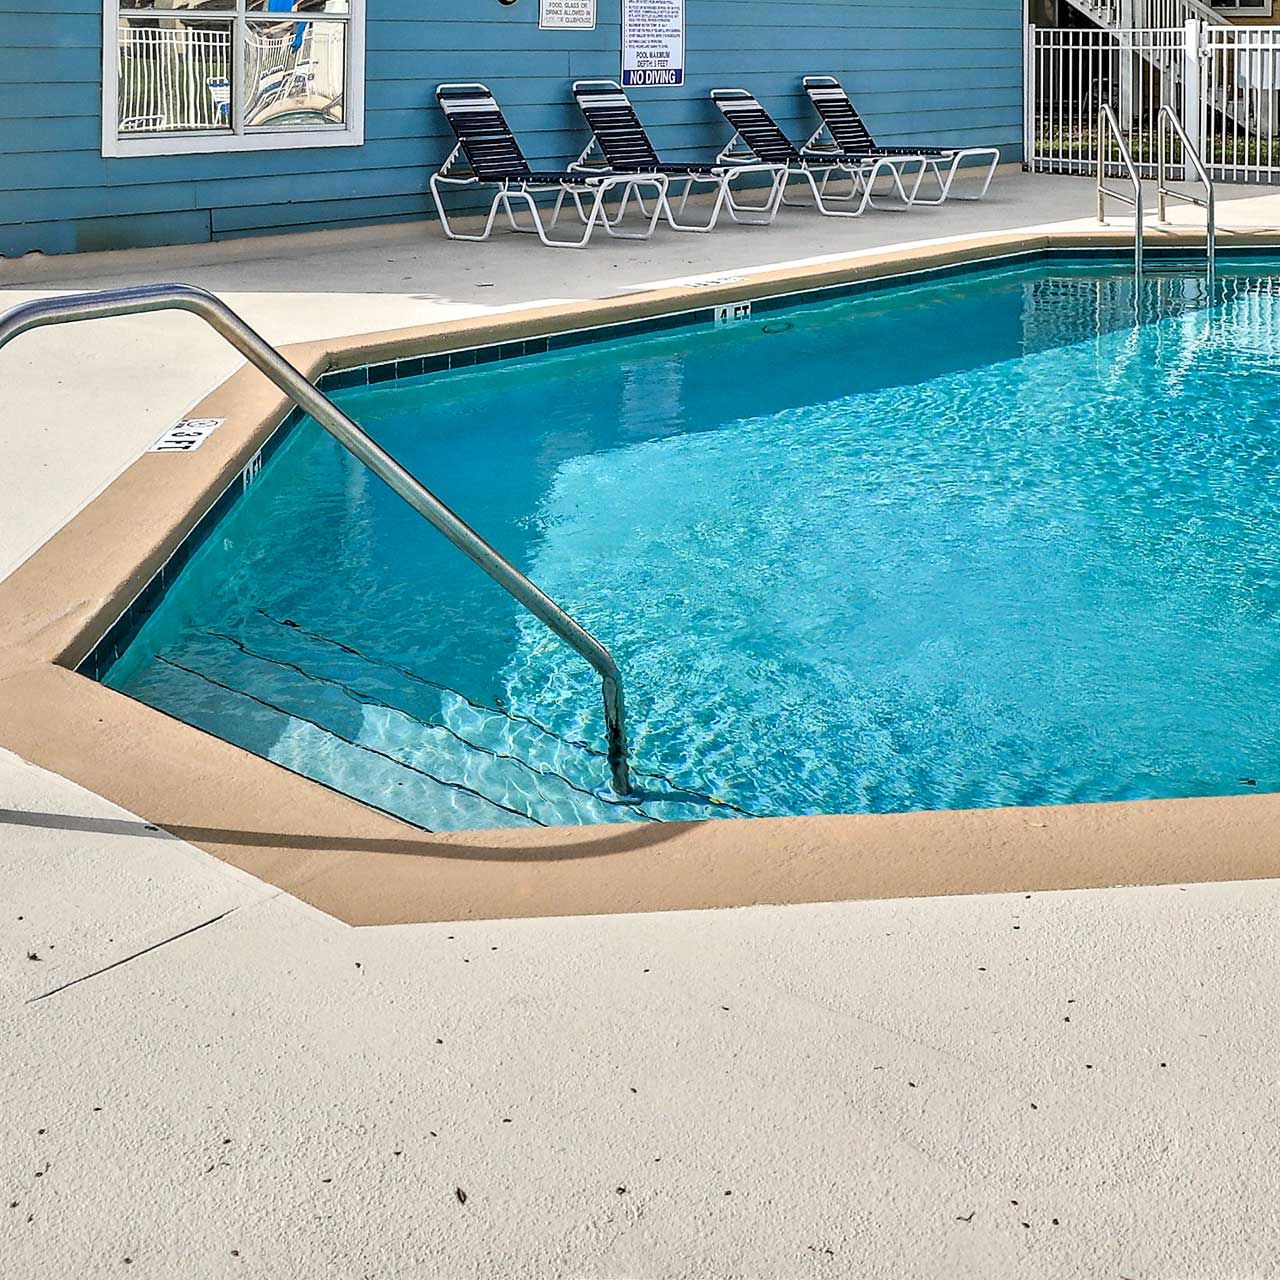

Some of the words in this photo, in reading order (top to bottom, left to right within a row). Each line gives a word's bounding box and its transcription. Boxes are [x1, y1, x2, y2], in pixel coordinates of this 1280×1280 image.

[636, 51, 649, 59] POOL
[630, 71, 644, 84] NO
[646, 70, 676, 84] DIVING
